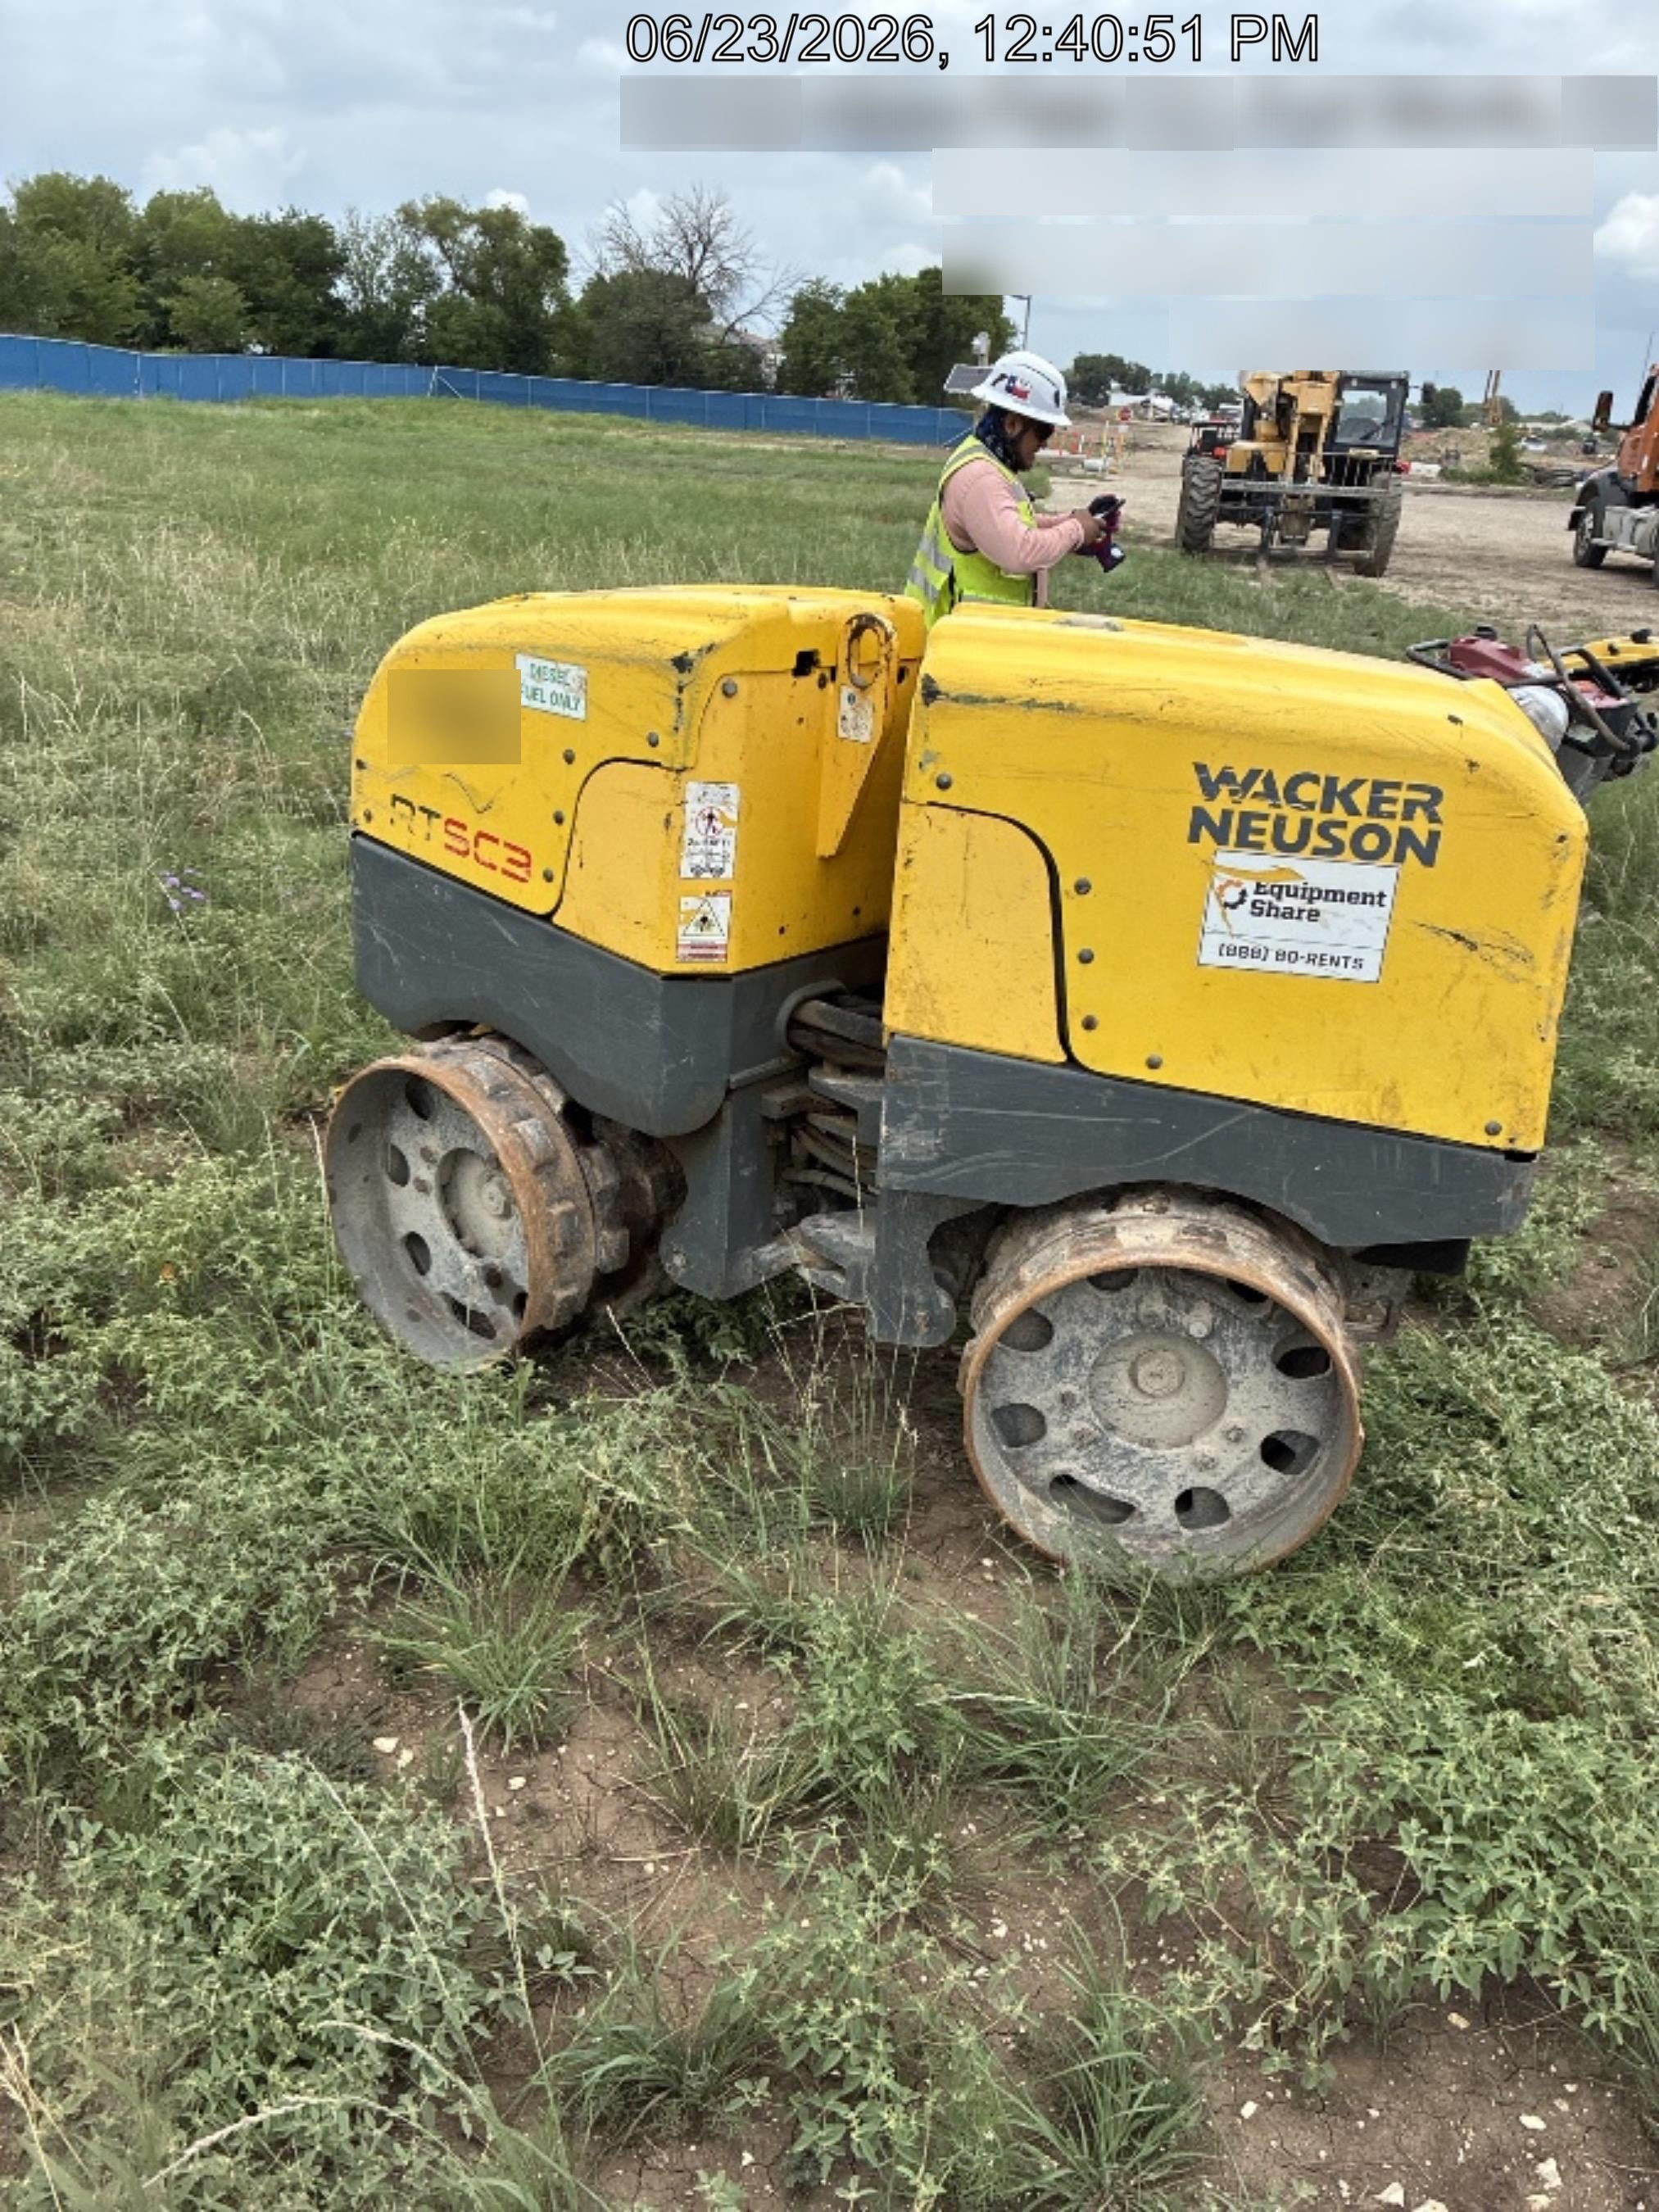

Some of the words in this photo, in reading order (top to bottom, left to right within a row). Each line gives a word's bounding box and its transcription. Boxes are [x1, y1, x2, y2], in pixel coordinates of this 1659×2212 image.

[521, 682, 547, 704] UEL
[550, 690, 581, 712] ONLY
[1191, 761, 1444, 825] WACKER
[1187, 805, 1441, 868] NEUSON
[1253, 882, 1388, 908] Equipment
[1249, 899, 1321, 922] Share
[1218, 942, 1269, 963] (888)
[1274, 949, 1365, 971] 80-RENTS
